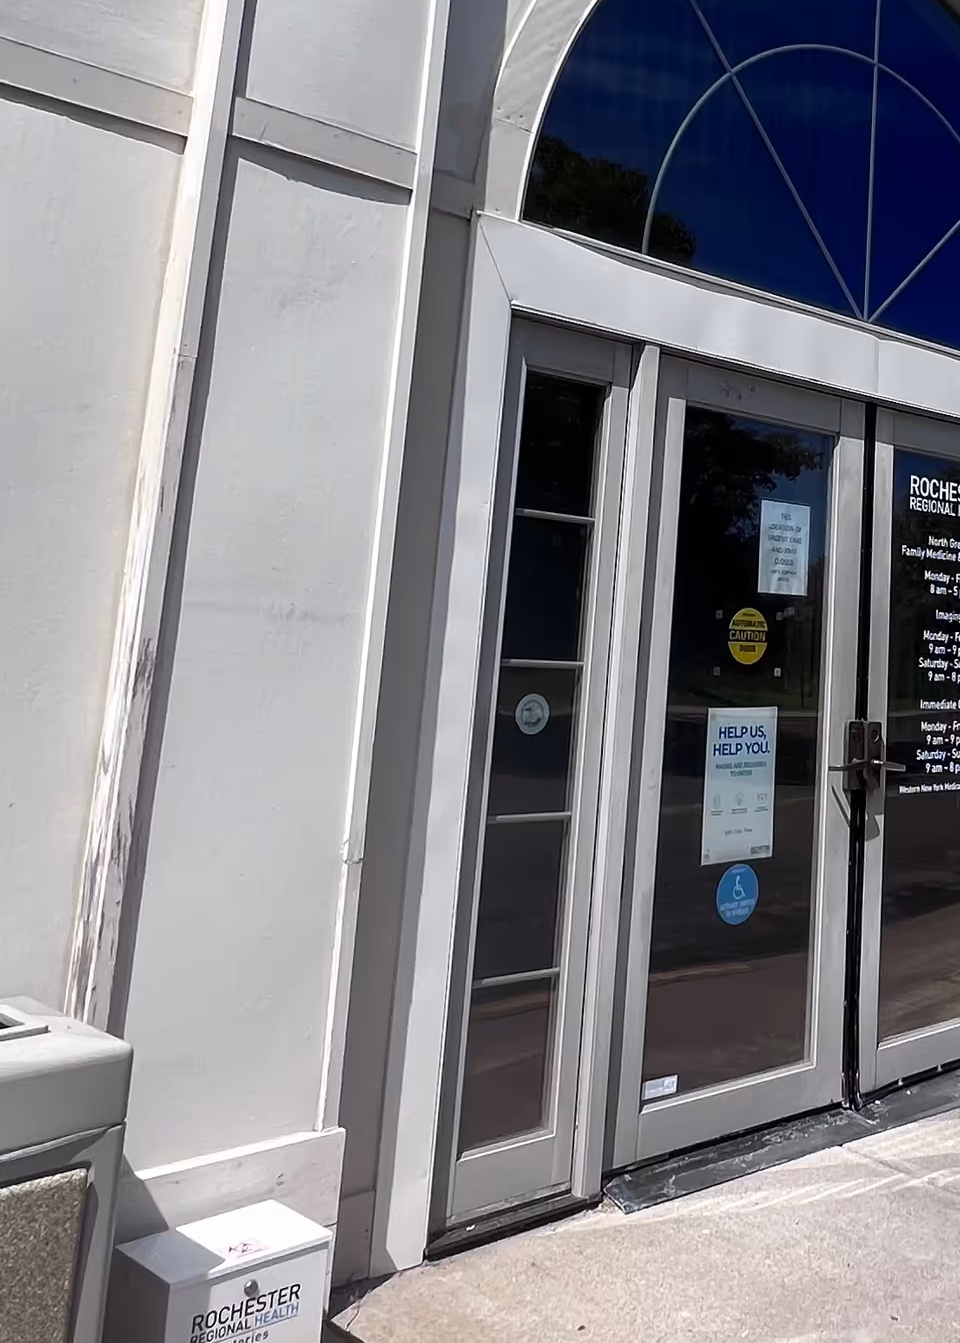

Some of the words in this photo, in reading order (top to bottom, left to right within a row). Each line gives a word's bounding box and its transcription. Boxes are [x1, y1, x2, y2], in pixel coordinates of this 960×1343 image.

[910, 496, 956, 516] REGIONAL
[928, 535, 948, 548] North
[901, 545, 925, 560] Family
[926, 548, 956, 562] Medicine
[924, 570, 950, 584] Monday
[930, 584, 935, 594] 8
[936, 587, 947, 595] am
[953, 586, 958, 596] 5
[729, 630, 766, 641] CAUTION
[923, 630, 949, 643] Monday
[929, 643, 934, 654] 9
[934, 646, 945, 654] am
[952, 645, 957, 655] 9
[919, 657, 948, 670] Saturday
[928, 671, 933, 681] 9
[951, 672, 956, 682] 8
[920, 699, 957, 709] Immediate
[719, 726, 748, 739] HELP
[750, 725, 767, 739] US,
[921, 721, 947, 733] Monday
[926, 735, 931, 745] 9
[932, 737, 943, 745] am
[950, 734, 955, 744] 9
[713, 743, 743, 756] HELP
[745, 741, 770, 755] YOU.
[916, 749, 946, 760] Saturday
[925, 763, 930, 773] 9
[932, 765, 942, 773] am
[949, 762, 954, 772] 8
[921, 784, 932, 792] New
[933, 783, 943, 791] York
[191, 1284, 300, 1334] ROCHESTER
[255, 1302, 299, 1326] HEALTH
